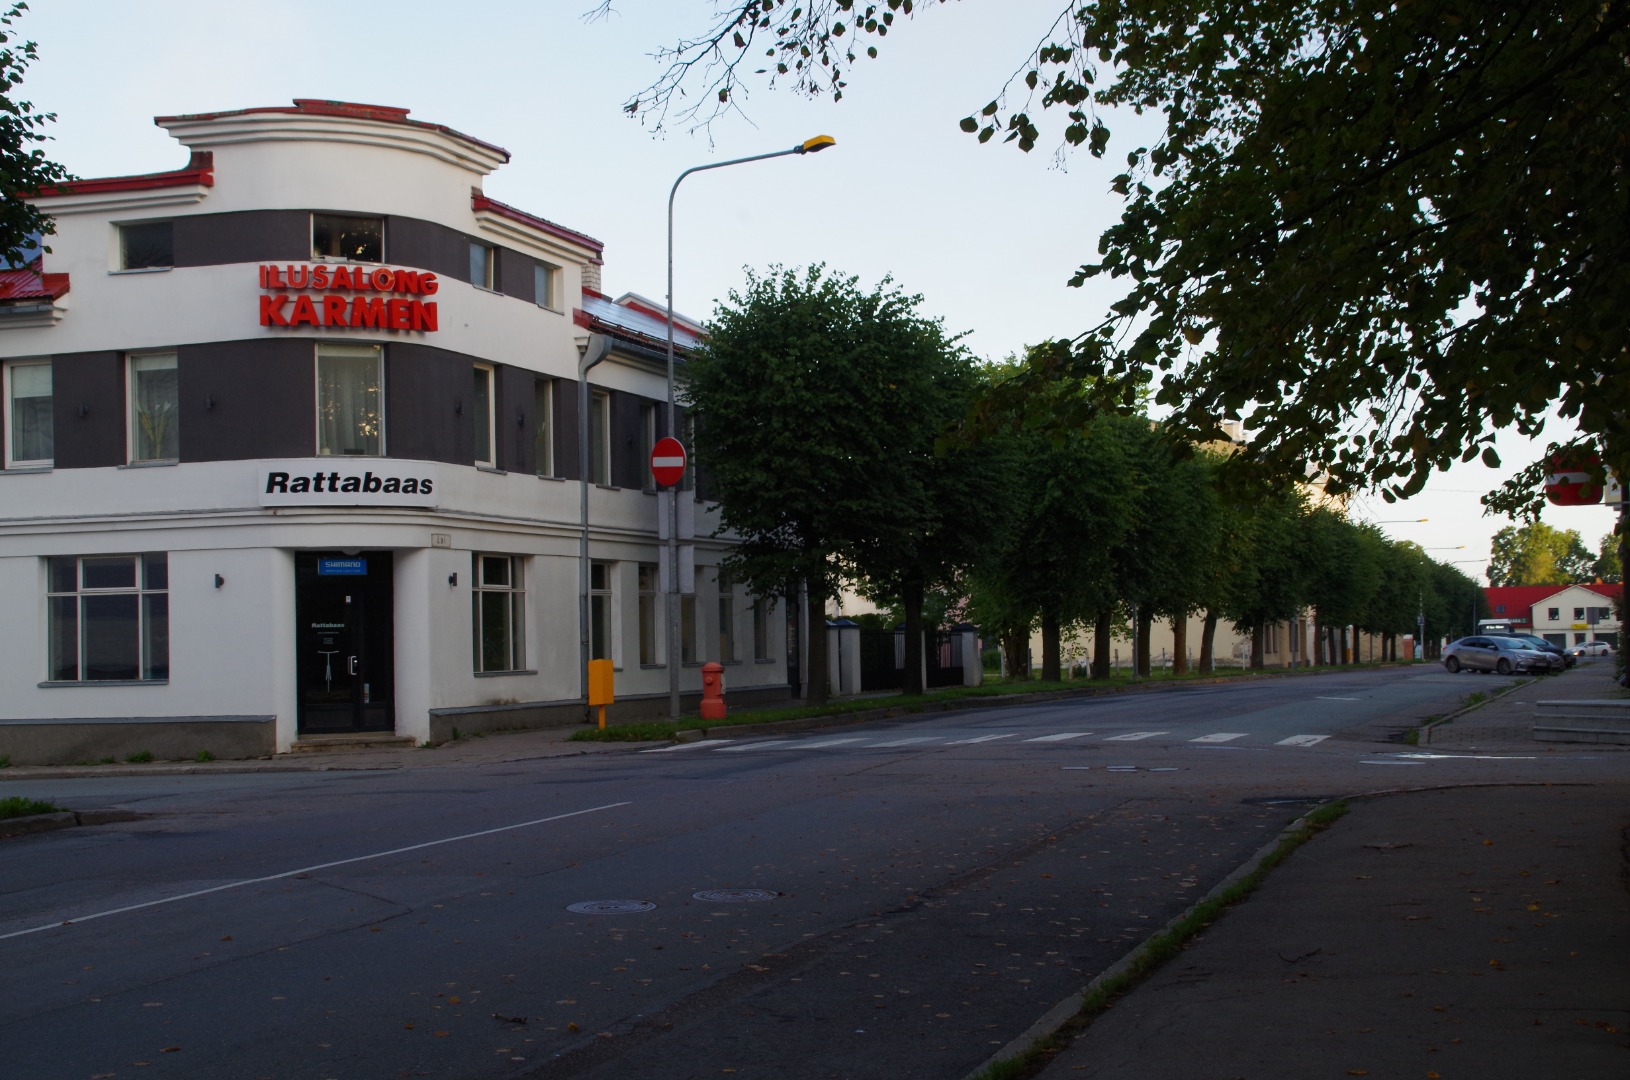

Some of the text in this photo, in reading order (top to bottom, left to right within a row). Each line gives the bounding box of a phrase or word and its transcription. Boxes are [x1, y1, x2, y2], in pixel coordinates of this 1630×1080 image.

[259, 264, 438, 296] ILUSALONG
[259, 294, 438, 332] KARMEN
[265, 471, 433, 495] Rattabaas
